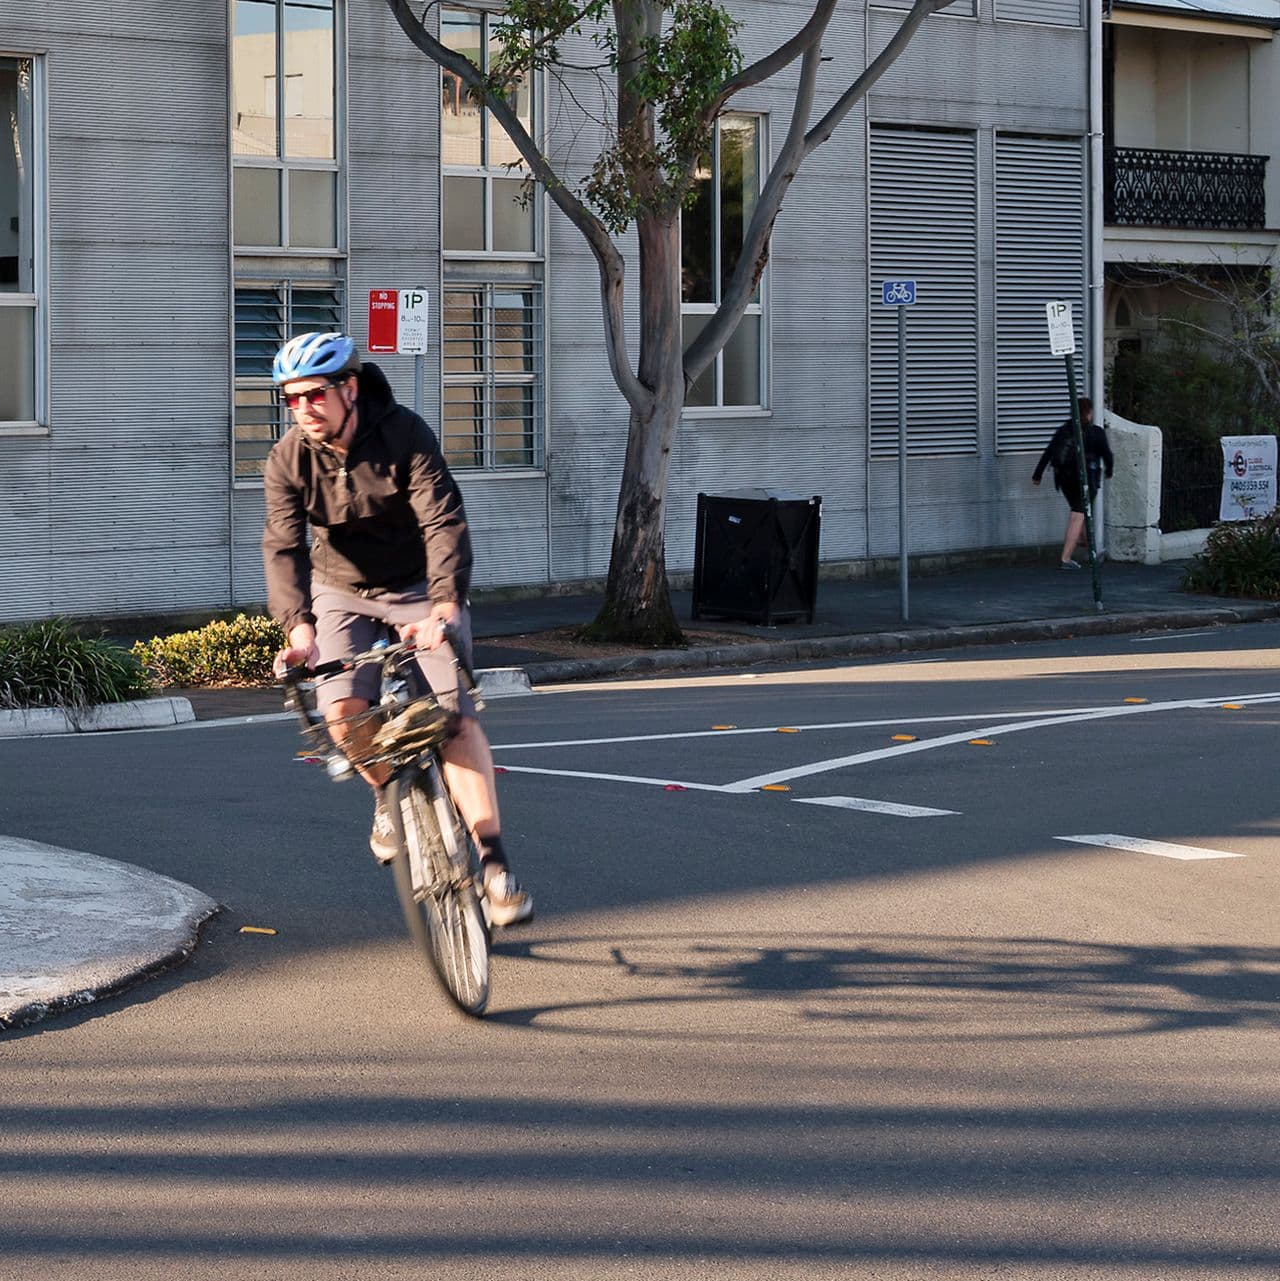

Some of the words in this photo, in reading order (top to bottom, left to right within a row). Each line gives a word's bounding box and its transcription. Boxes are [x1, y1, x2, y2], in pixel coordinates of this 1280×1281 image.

[371, 302, 395, 310] STOPPING
[404, 293, 423, 309] 1P
[1051, 304, 1067, 318] 1P
